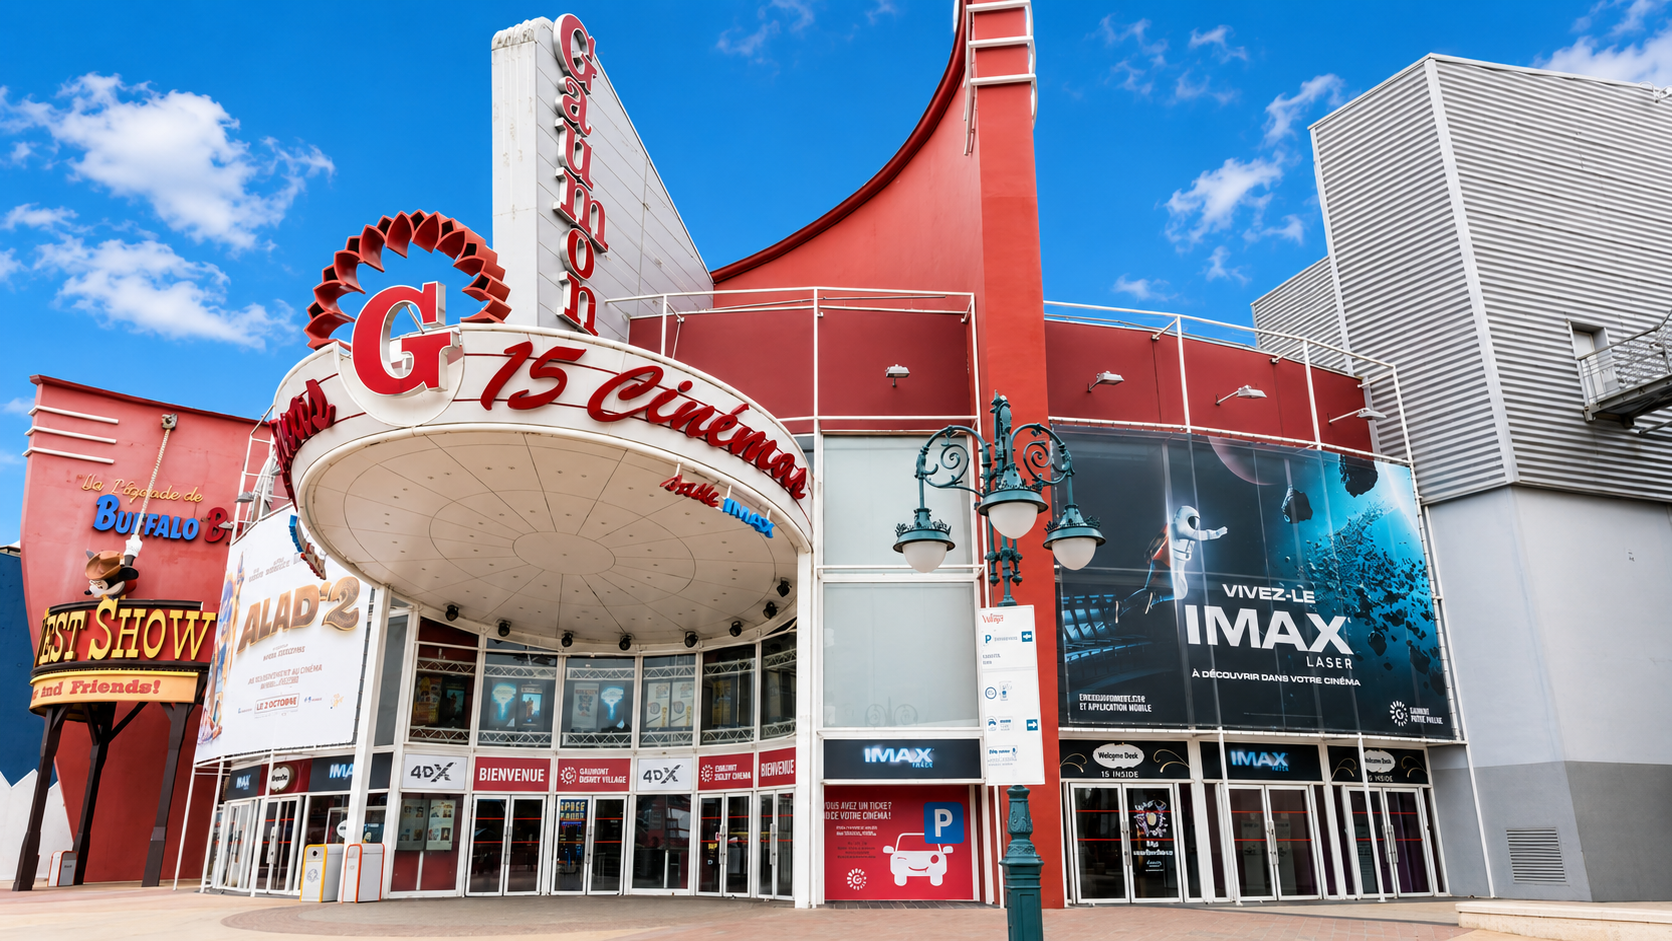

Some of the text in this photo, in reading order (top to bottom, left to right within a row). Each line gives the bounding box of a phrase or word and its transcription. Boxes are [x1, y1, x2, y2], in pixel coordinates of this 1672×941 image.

[353, 281, 456, 397] G
[480, 341, 806, 500] 15 Cinémas
[184, 487, 204, 502] de
[722, 498, 775, 538] IMAX
[35, 607, 86, 667] EST
[985, 634, 992, 644] P
[1185, 604, 1354, 655] IMAX
[1306, 656, 1353, 669] LASER
[69, 679, 162, 694] Friends!
[1191, 668, 1361, 687] À DÉCOUVRIR DANS VOTRE CINÉMA
[864, 747, 933, 763] IMAX
[1231, 751, 1288, 766] IMAX
[329, 763, 354, 778] IMA
[410, 761, 456, 783] 4DX
[479, 767, 545, 783] BIENVENUE
[643, 763, 682, 784] 4DX
[934, 808, 953, 838] P
